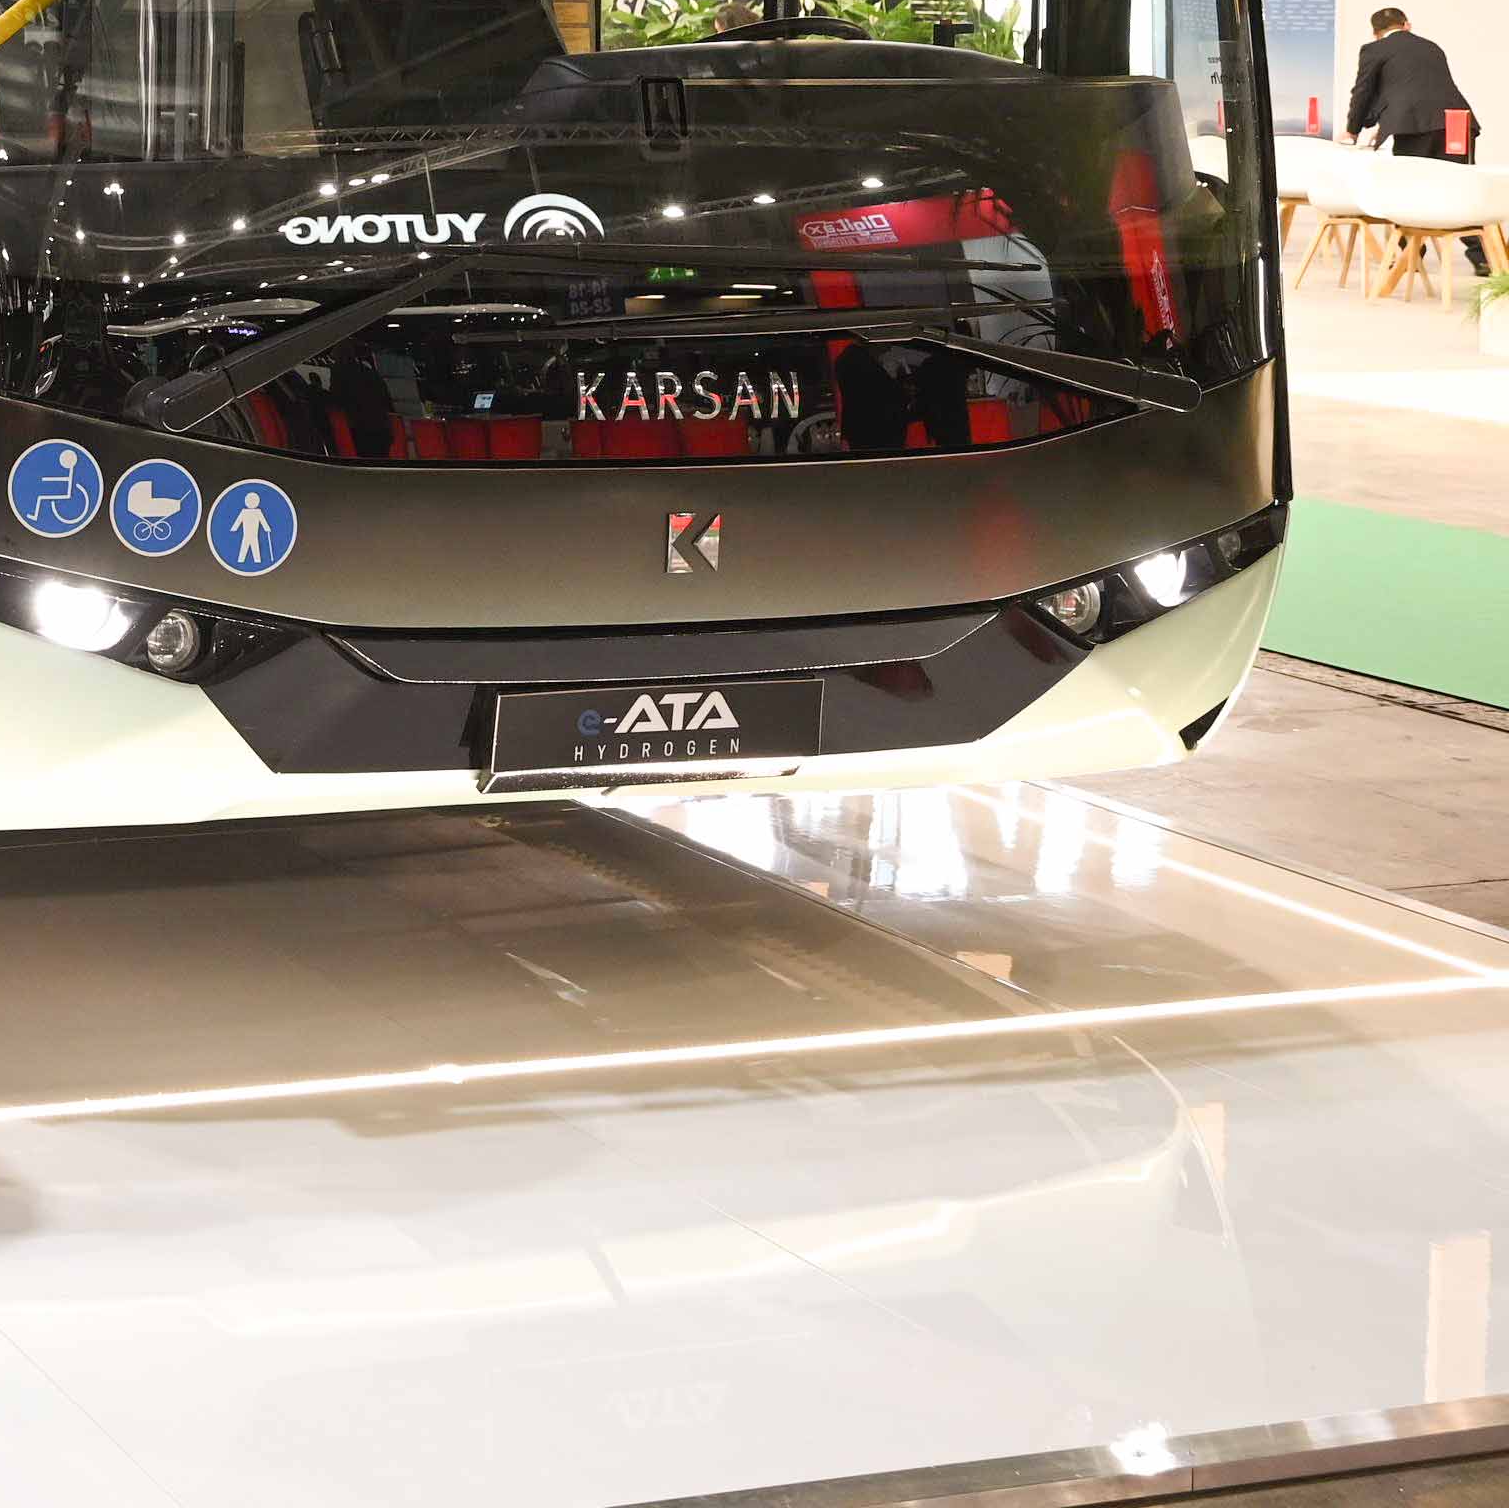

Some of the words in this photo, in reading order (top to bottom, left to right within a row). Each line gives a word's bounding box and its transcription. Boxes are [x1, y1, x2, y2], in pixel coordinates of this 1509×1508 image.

[576, 369, 800, 421] KARSAN
[577, 690, 740, 737] e-ATA
[573, 737, 741, 762] HYDROGEN
